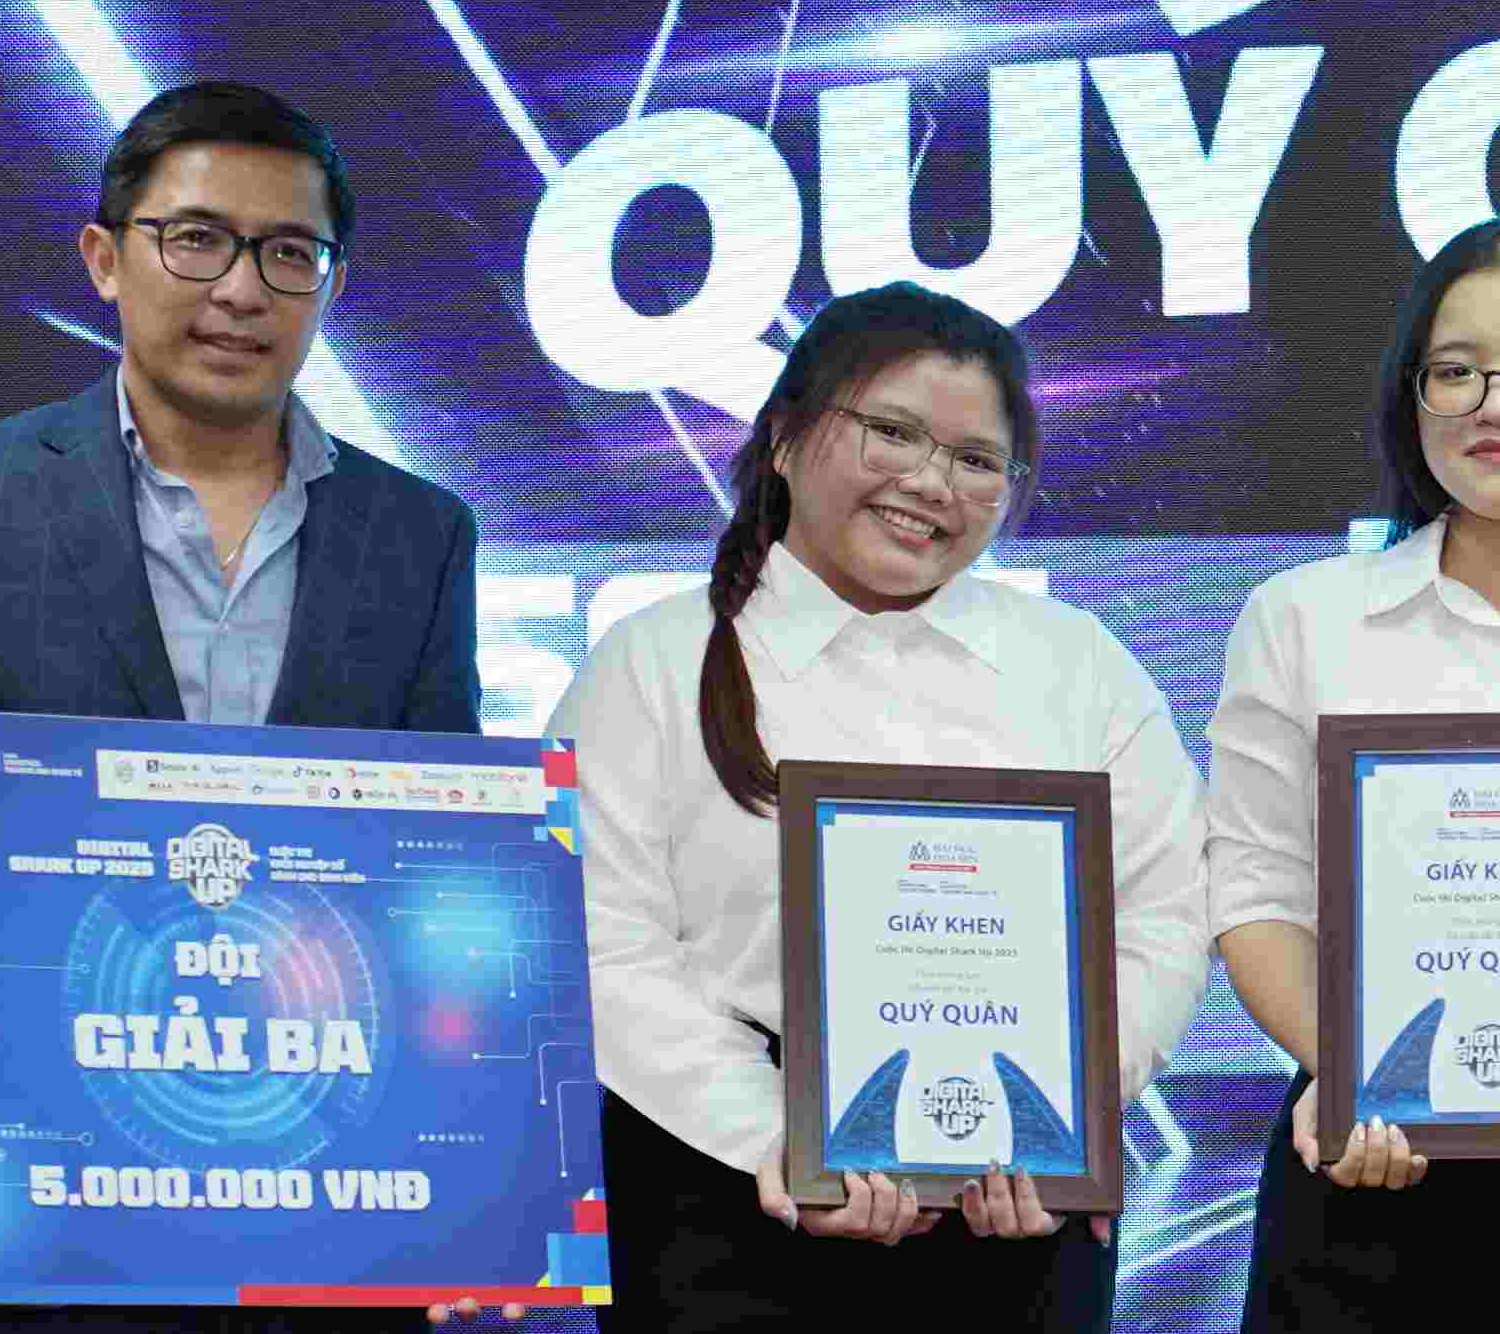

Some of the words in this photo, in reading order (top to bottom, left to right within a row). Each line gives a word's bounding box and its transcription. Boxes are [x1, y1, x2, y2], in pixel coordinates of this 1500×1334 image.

[165, 832, 261, 862] DIGITAL
[9, 855, 74, 875] SHARK
[76, 857, 102, 876] UP
[167, 857, 253, 882] SHARK
[1426, 854, 1478, 881] GIẤY
[194, 877, 239, 905] UP
[887, 908, 939, 934] GIẤY
[945, 916, 1006, 935] KHEN
[174, 933, 262, 986] ĐỘI
[1415, 947, 1472, 974] QUÝ
[879, 998, 935, 1025] QUÝ
[941, 1000, 1019, 1027] QUÂN
[72, 995, 251, 1073] GIẢI
[267, 1018, 373, 1075] BA
[28, 1164, 315, 1211] 5.000.000
[324, 1169, 432, 1211] VNĐ
